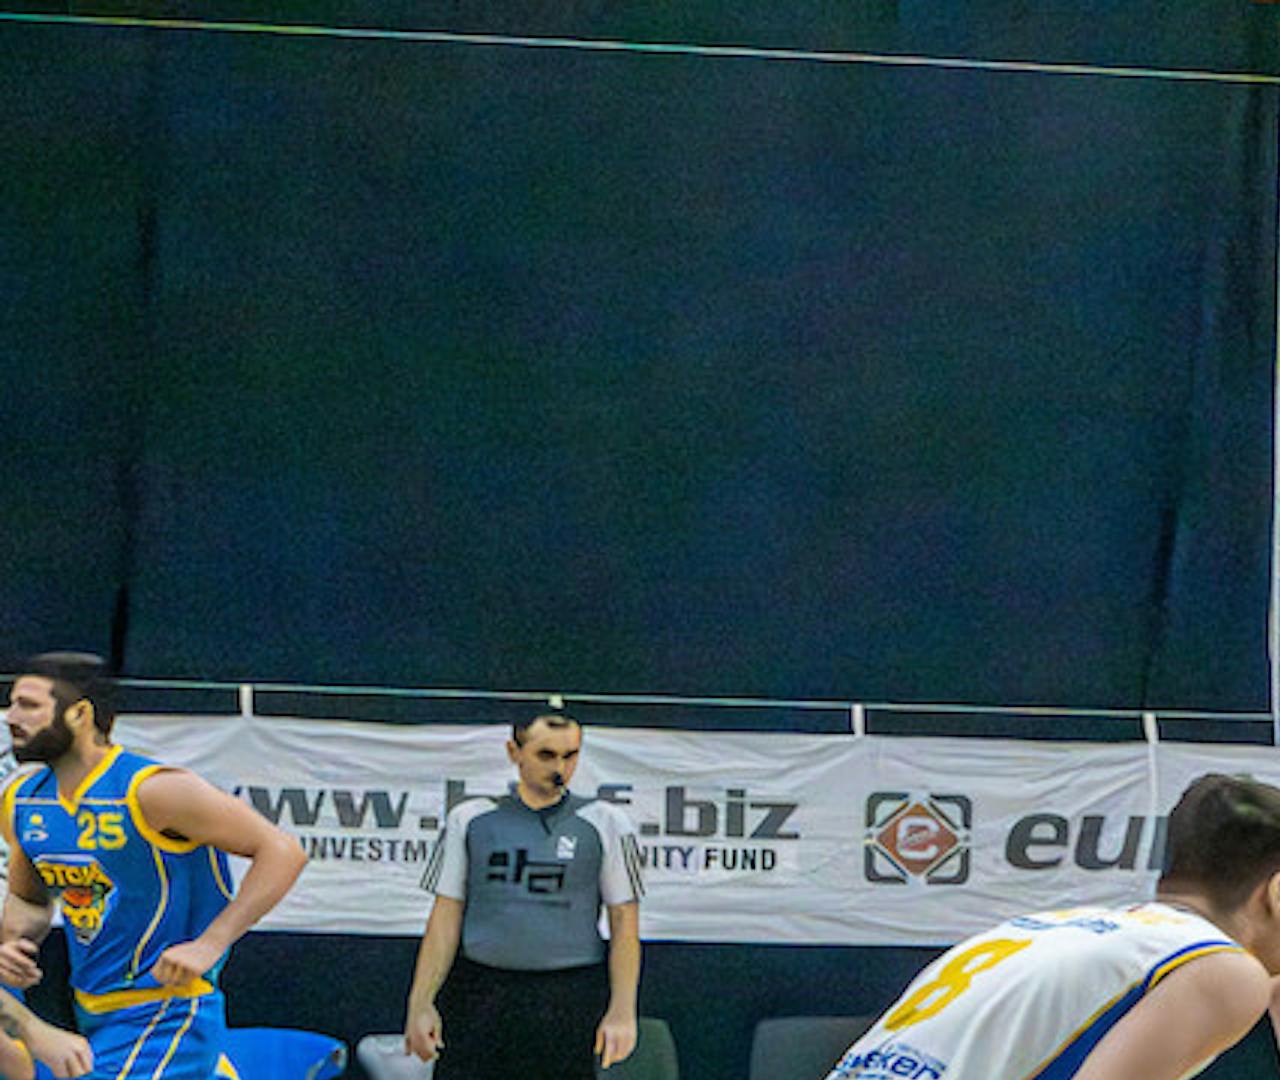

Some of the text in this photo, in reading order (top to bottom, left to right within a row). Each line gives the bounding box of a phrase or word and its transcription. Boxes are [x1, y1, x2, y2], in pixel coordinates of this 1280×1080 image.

[77, 811, 128, 850] 25
[704, 848, 776, 871] FUND
[883, 938, 1033, 1032] 8
